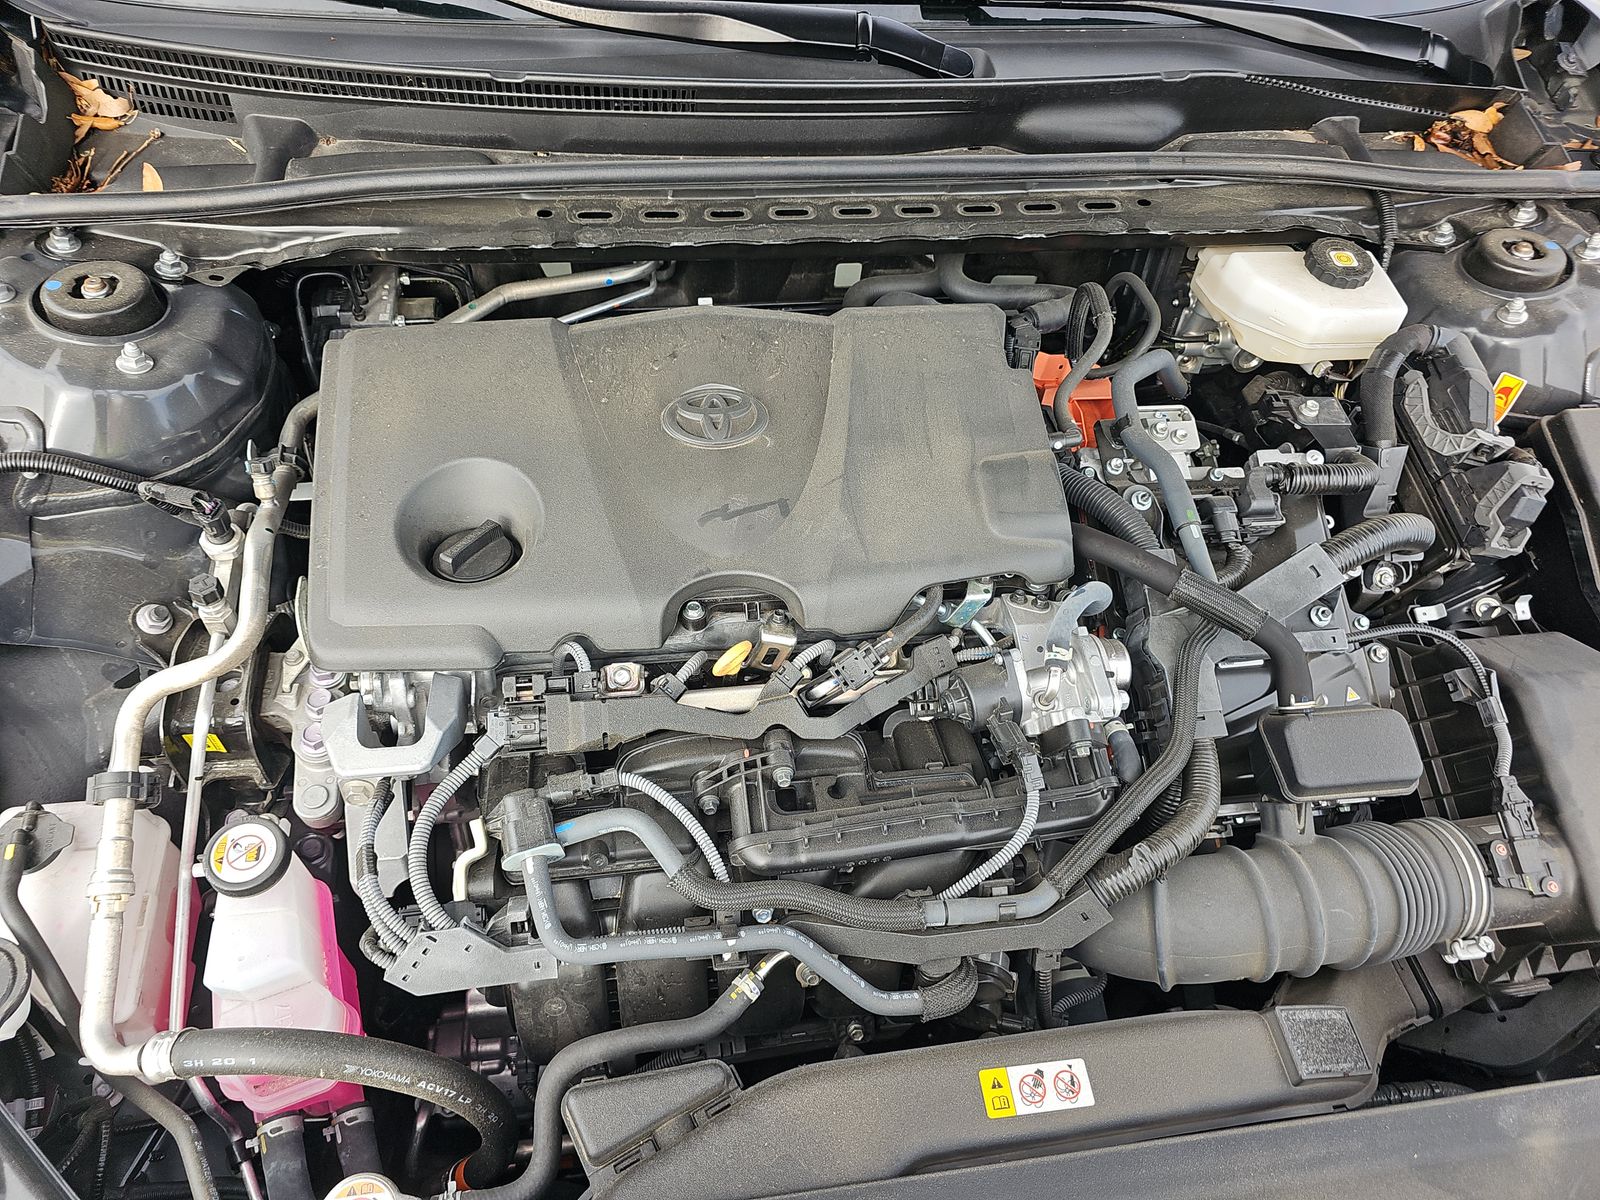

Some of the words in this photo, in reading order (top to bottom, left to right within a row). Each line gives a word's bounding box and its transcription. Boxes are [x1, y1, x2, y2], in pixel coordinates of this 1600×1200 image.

[211, 1057, 236, 1065] 20
[359, 1066, 412, 1085] YOKOHAMA
[416, 1080, 457, 1098] ACV17
[458, 1094, 472, 1104] LP
[200, 1156, 213, 1181] WATER
